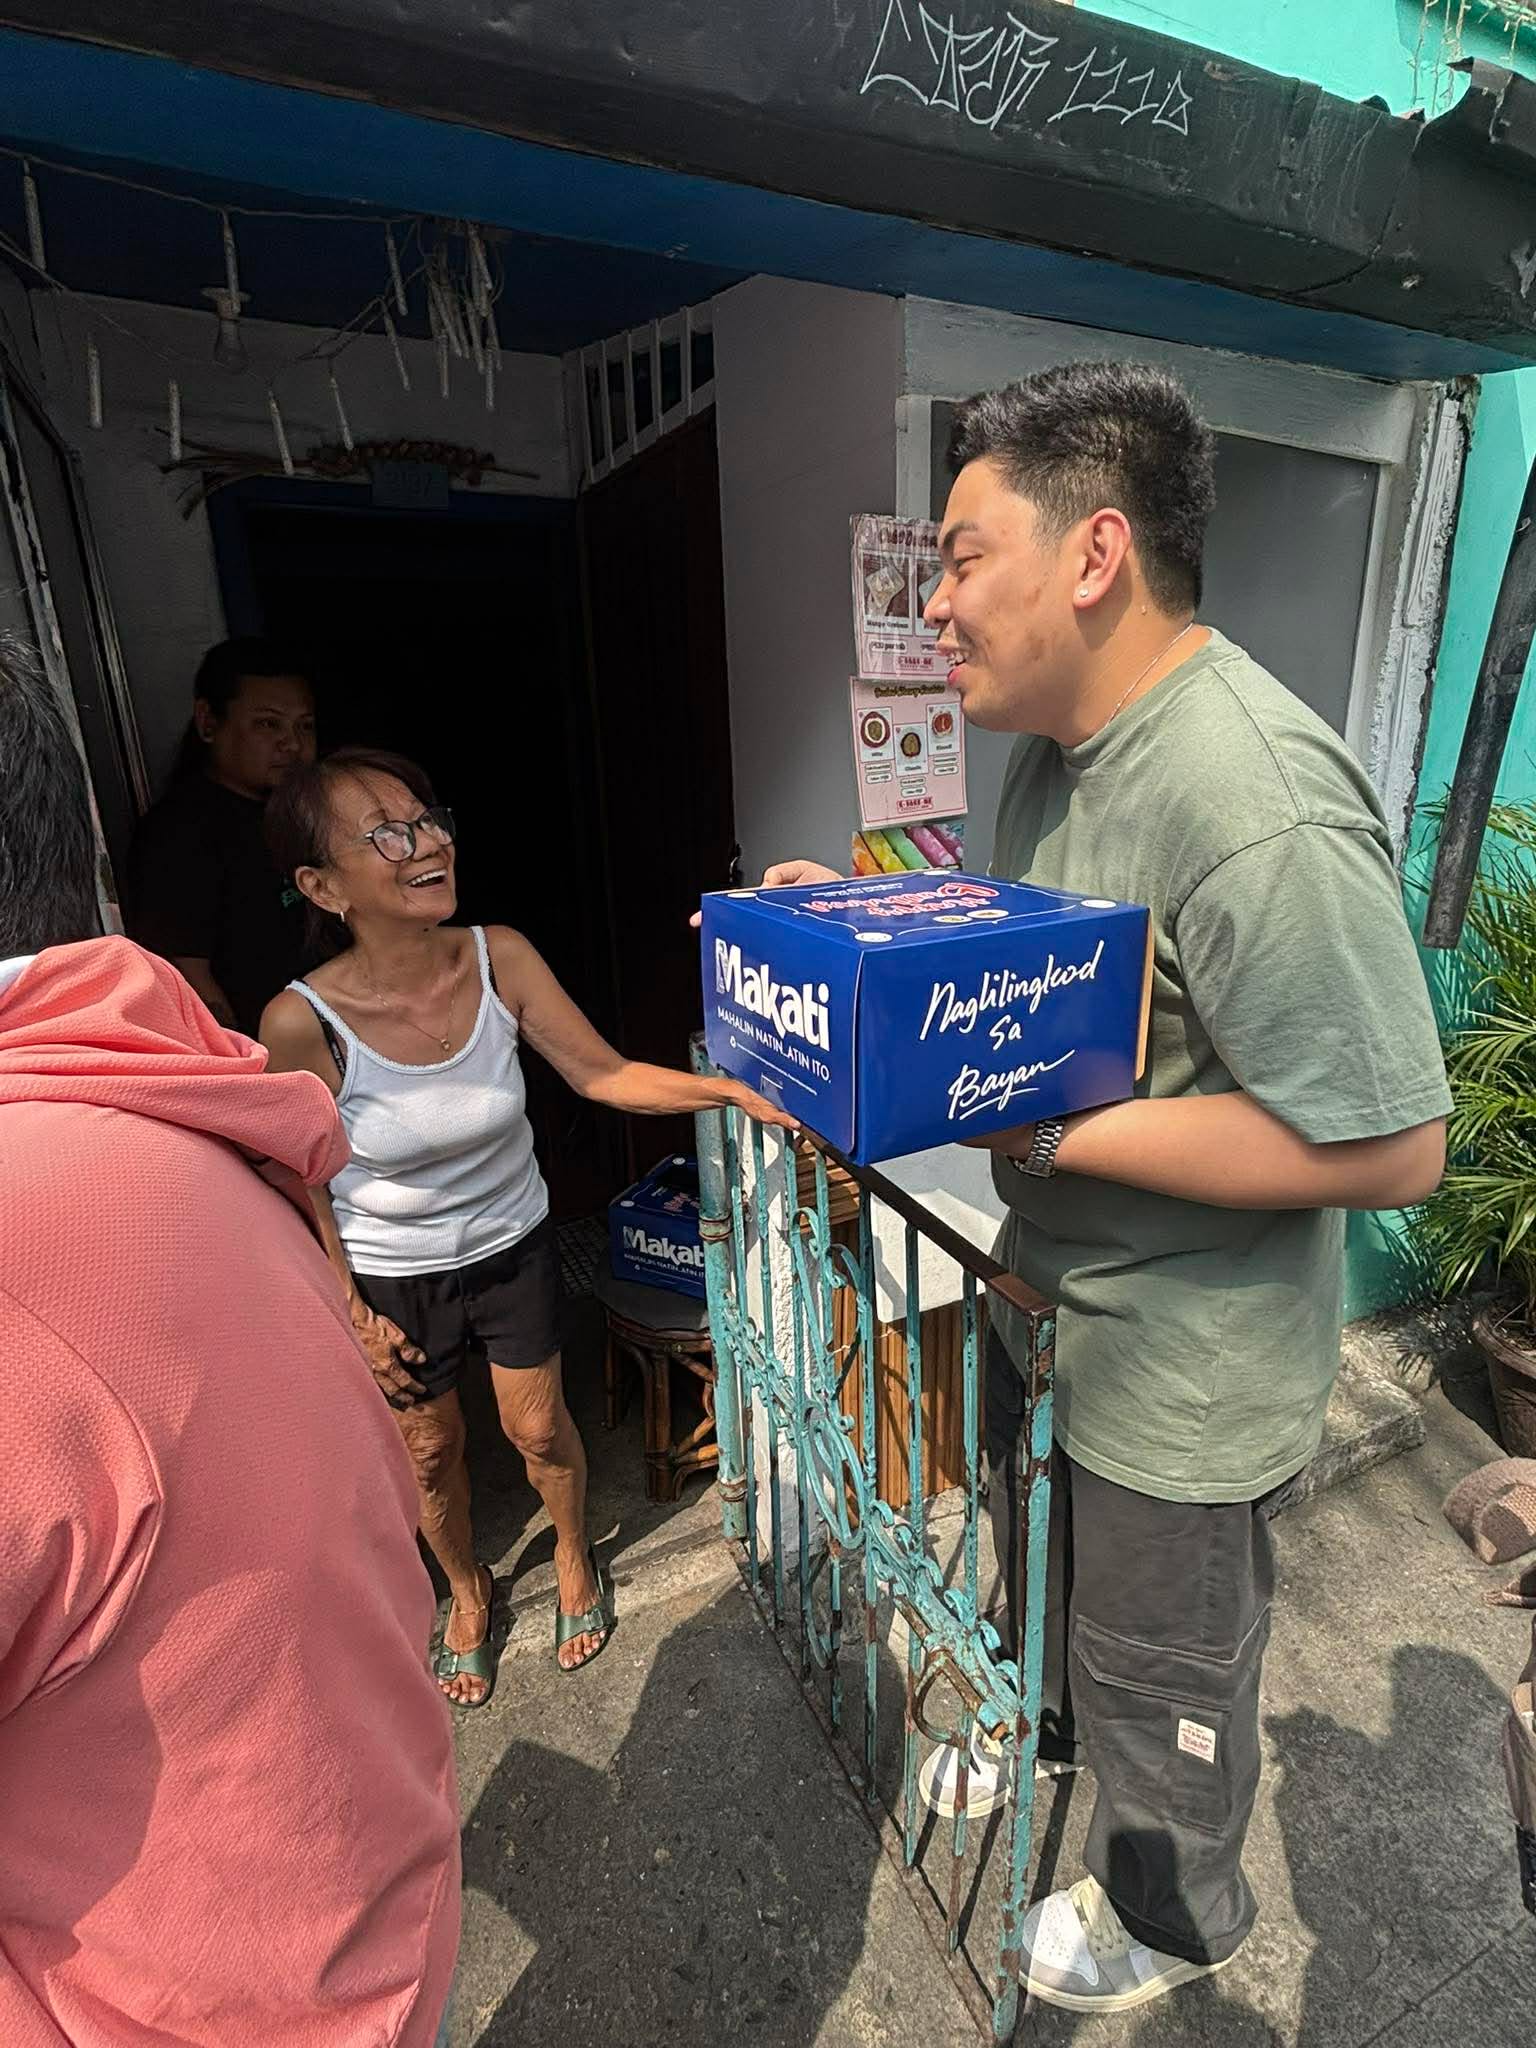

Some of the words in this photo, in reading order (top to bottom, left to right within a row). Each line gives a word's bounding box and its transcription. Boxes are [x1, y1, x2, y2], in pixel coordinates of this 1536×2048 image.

[715, 937, 830, 1051] Makati
[919, 939, 1105, 1041] Naglilingkod
[717, 1005, 754, 1038] MAHALIN
[812, 1058, 832, 1084] ITO.
[947, 1049, 1075, 1120] Bayan
[623, 1225, 704, 1268] Makat
